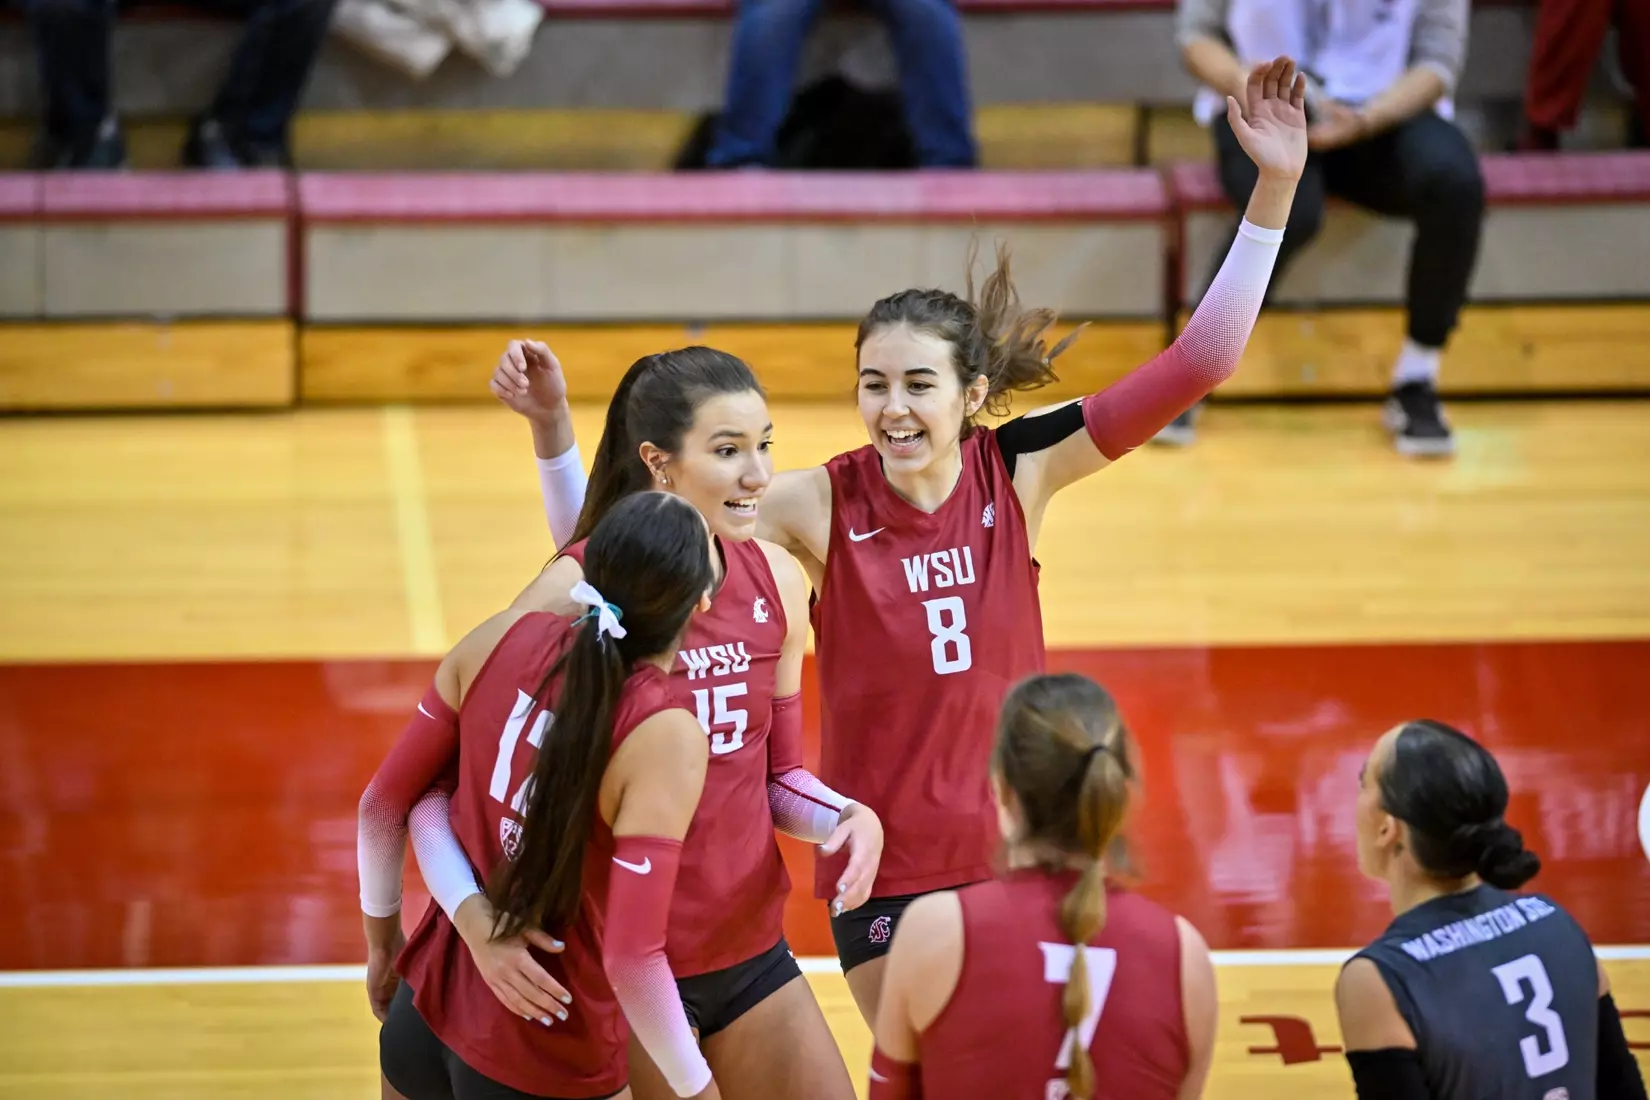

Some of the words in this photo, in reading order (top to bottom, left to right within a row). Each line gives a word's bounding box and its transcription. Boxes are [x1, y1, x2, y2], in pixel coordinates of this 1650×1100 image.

[900, 545, 976, 593] WSU
[678, 641, 752, 681] WSU
[920, 595, 972, 675] 8
[690, 681, 748, 754] 15
[1400, 902, 1528, 961] WASHINGTON
[1036, 940, 1118, 1070] 7
[1490, 953, 1570, 1079] 3
